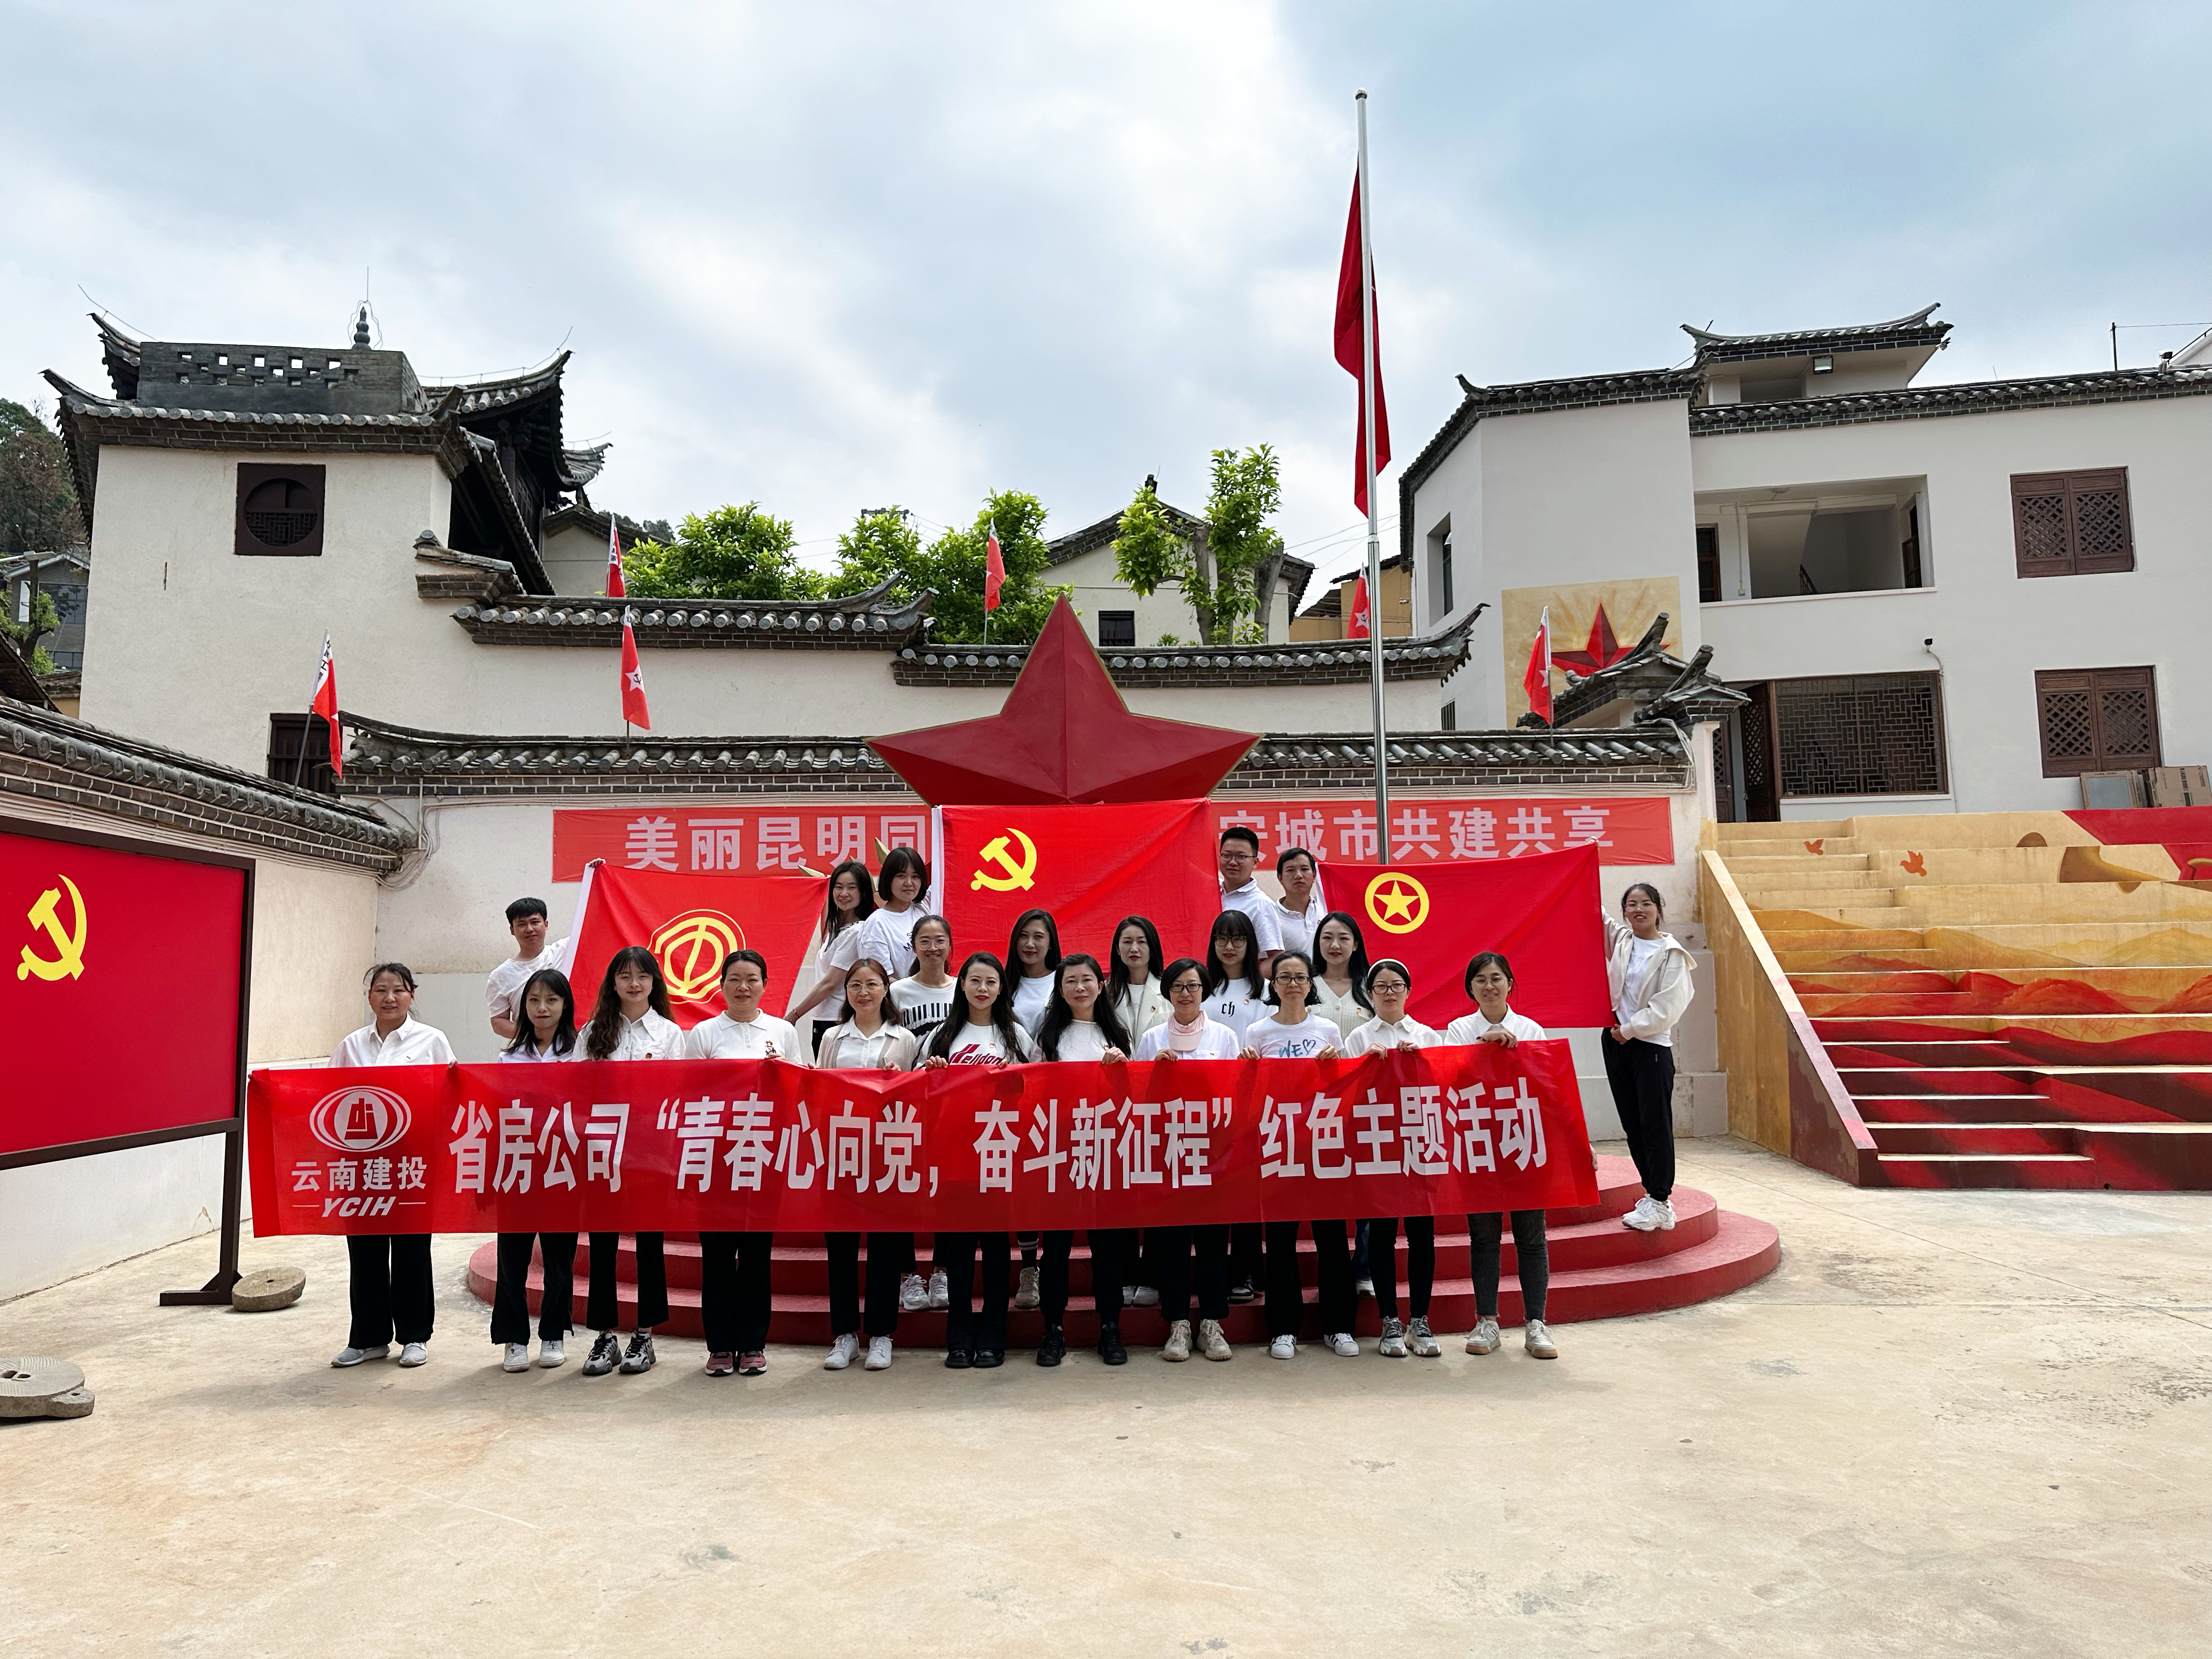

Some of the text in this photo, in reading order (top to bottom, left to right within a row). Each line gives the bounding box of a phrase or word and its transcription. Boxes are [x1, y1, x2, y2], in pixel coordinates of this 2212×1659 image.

[624, 815, 926, 872] 美丽昆明同
[1221, 1001, 1235, 1018] ch
[1279, 1040, 1303, 1058] WE
[291, 1156, 427, 1192] 云南建投
[321, 1197, 396, 1217] YCIH
